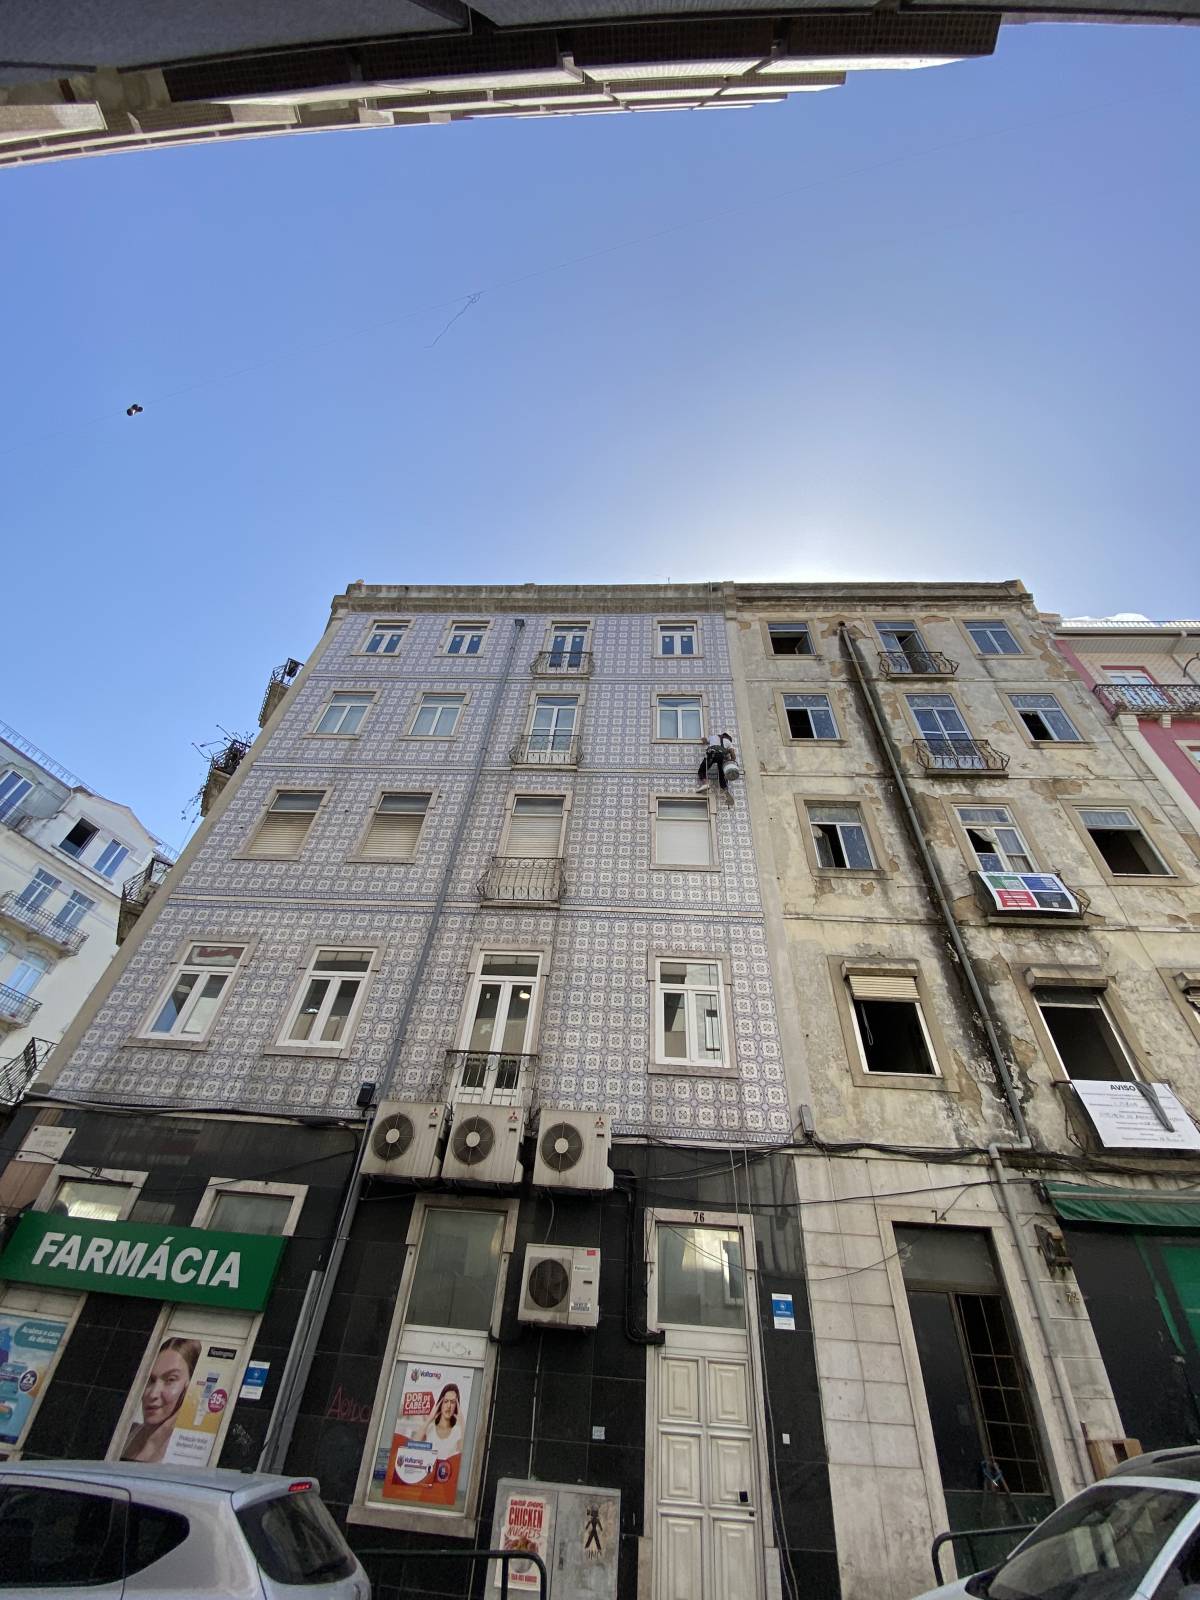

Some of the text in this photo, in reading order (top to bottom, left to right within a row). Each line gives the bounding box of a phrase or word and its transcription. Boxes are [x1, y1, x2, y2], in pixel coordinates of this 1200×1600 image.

[1109, 1084, 1137, 1092] AVISO
[693, 1211, 704, 1223] 76
[31, 1231, 242, 1289] FARMÁCIA
[406, 1393, 422, 1402] DOR
[508, 1506, 543, 1529] CHICKEN
[507, 1526, 541, 1539] NUGGETS
